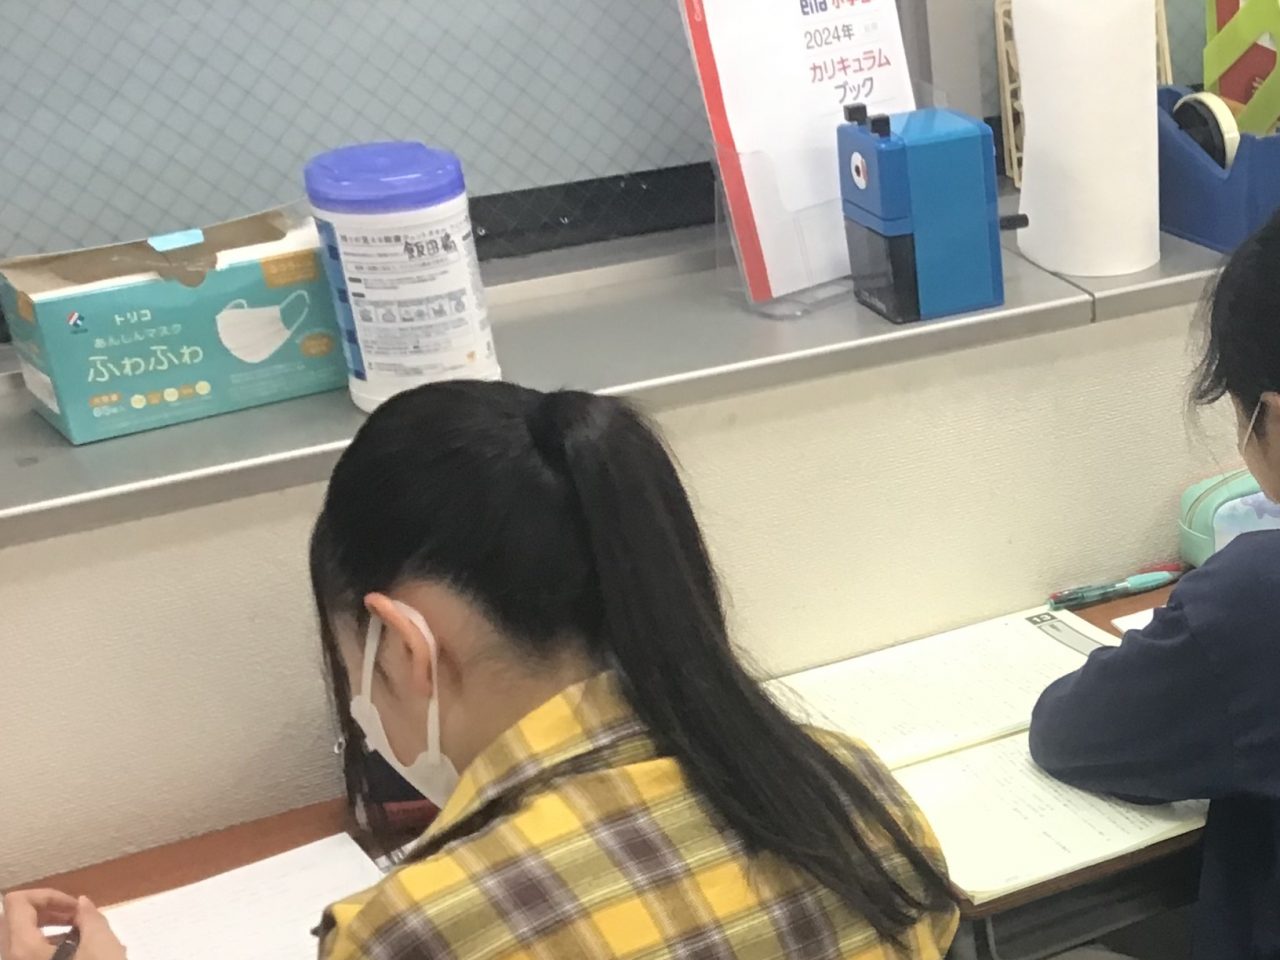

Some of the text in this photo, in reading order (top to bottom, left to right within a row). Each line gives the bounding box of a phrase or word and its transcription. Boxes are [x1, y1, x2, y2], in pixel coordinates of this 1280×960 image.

[804, 24, 855, 49] 2024年
[810, 48, 891, 83] カリキュラム
[834, 77, 874, 104] ブック
[114, 309, 151, 325] トリコ
[94, 323, 182, 348] あんしんマスク
[88, 346, 203, 382] ふわふわ
